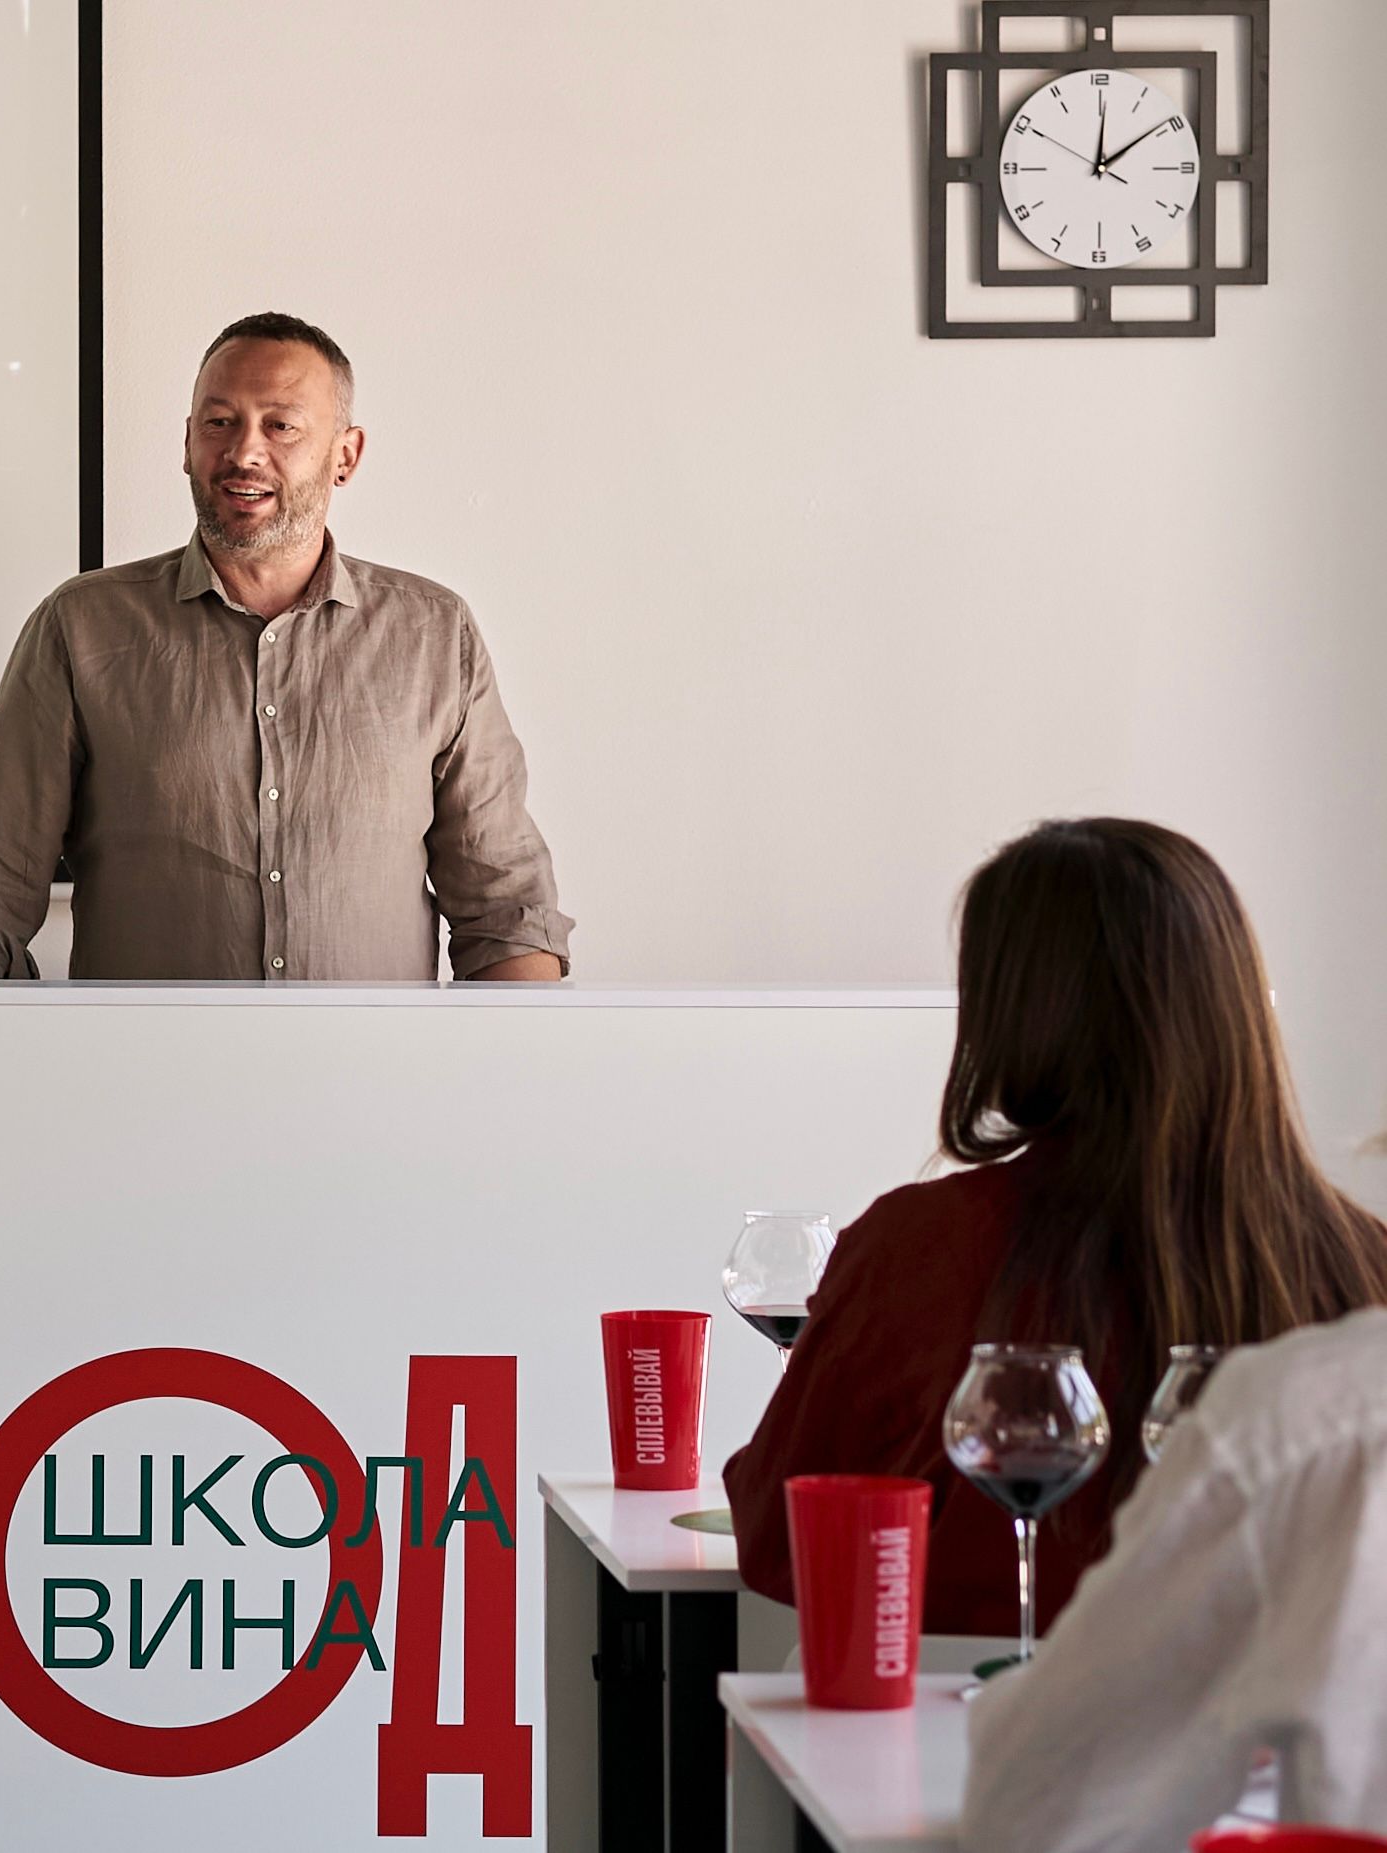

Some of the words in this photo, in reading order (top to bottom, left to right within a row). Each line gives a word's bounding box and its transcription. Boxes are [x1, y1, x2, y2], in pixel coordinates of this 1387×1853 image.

[1090, 73, 1110, 86] 12
[1014, 114, 1032, 135] 10
[1003, 162, 1018, 175] 9
[1180, 161, 1195, 174] 3
[1014, 204, 1030, 221] 8
[1168, 203, 1185, 219] 4
[1050, 237, 1062, 252] 7
[1135, 236, 1153, 252] 5
[1091, 251, 1107, 263] 6
[628, 1348, 666, 1464] СПЛЕВЫВАЙ
[43, 1452, 515, 1549] ШКОЛА
[871, 1526, 910, 1678] СПЛЕВЫВАЙ
[42, 1577, 387, 1671] ВИНА
